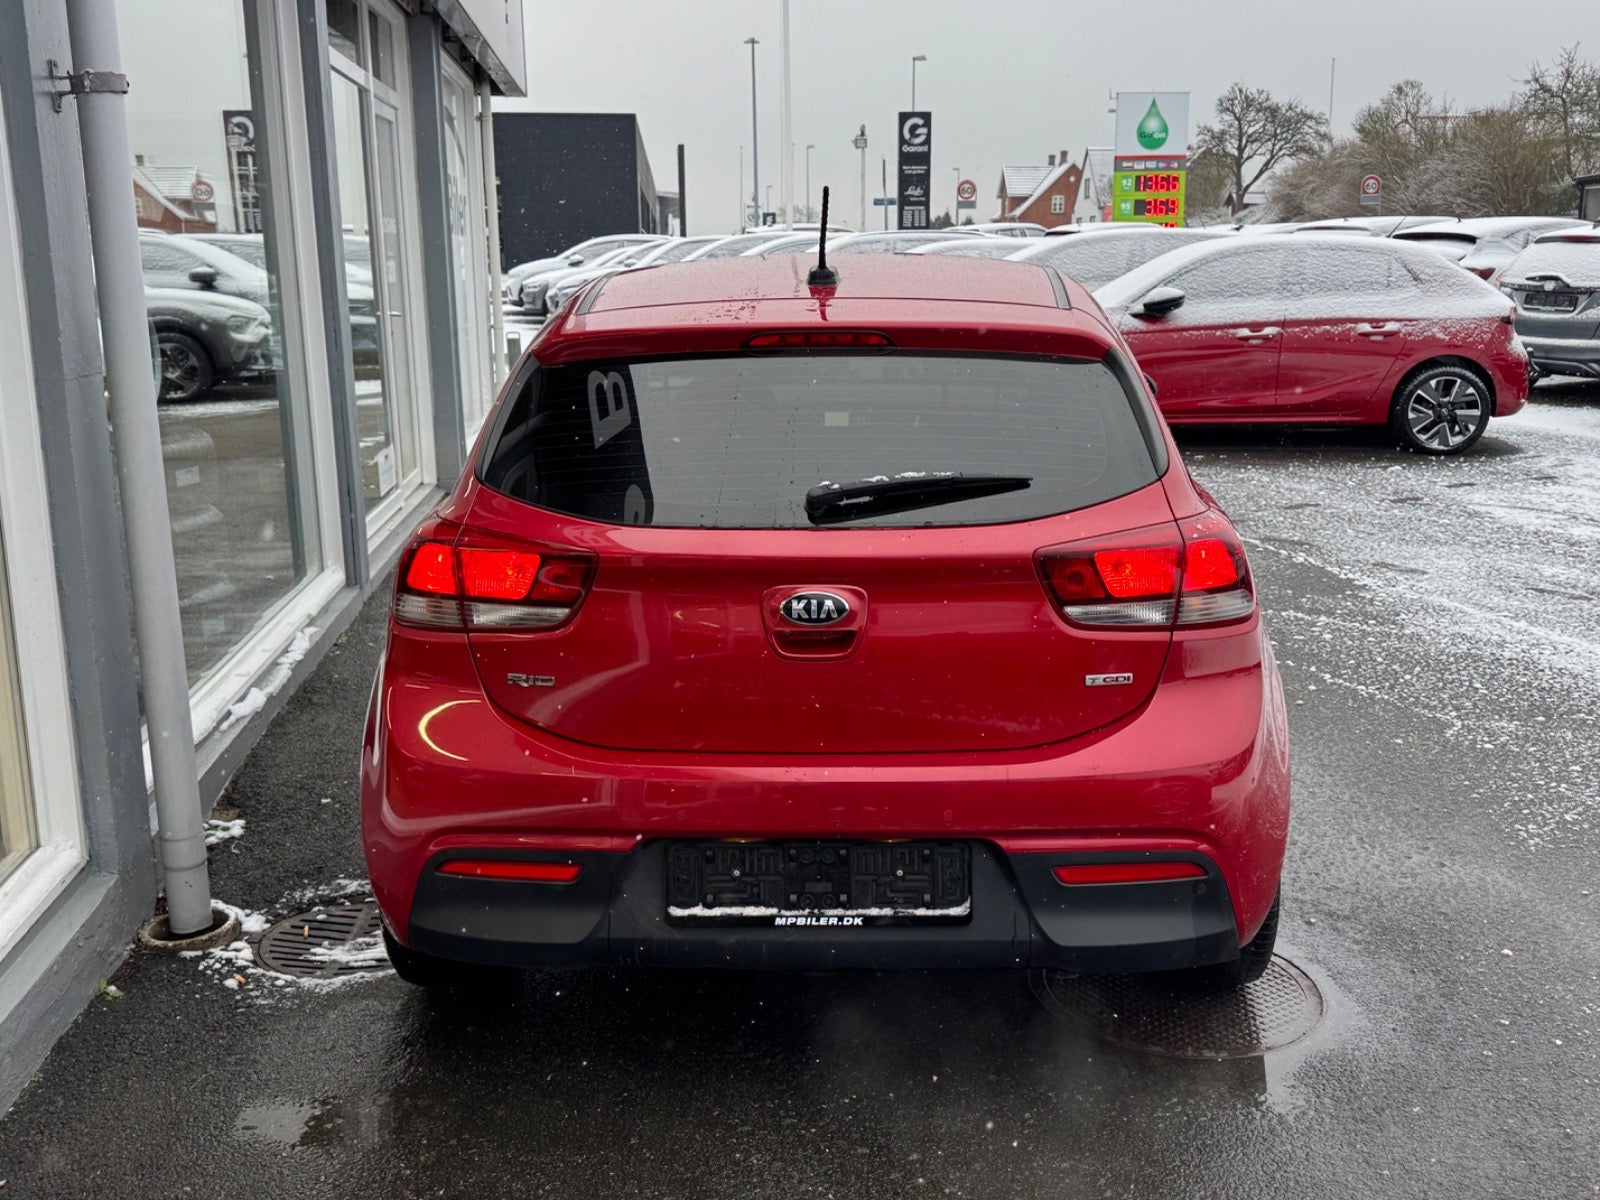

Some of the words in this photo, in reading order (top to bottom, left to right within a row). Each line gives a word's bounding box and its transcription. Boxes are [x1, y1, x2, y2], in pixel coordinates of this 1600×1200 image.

[961, 187, 972, 195] 60
[1366, 182, 1377, 191] 60
[791, 599, 838, 619] KIA
[775, 916, 864, 926] MPBILER.DK
